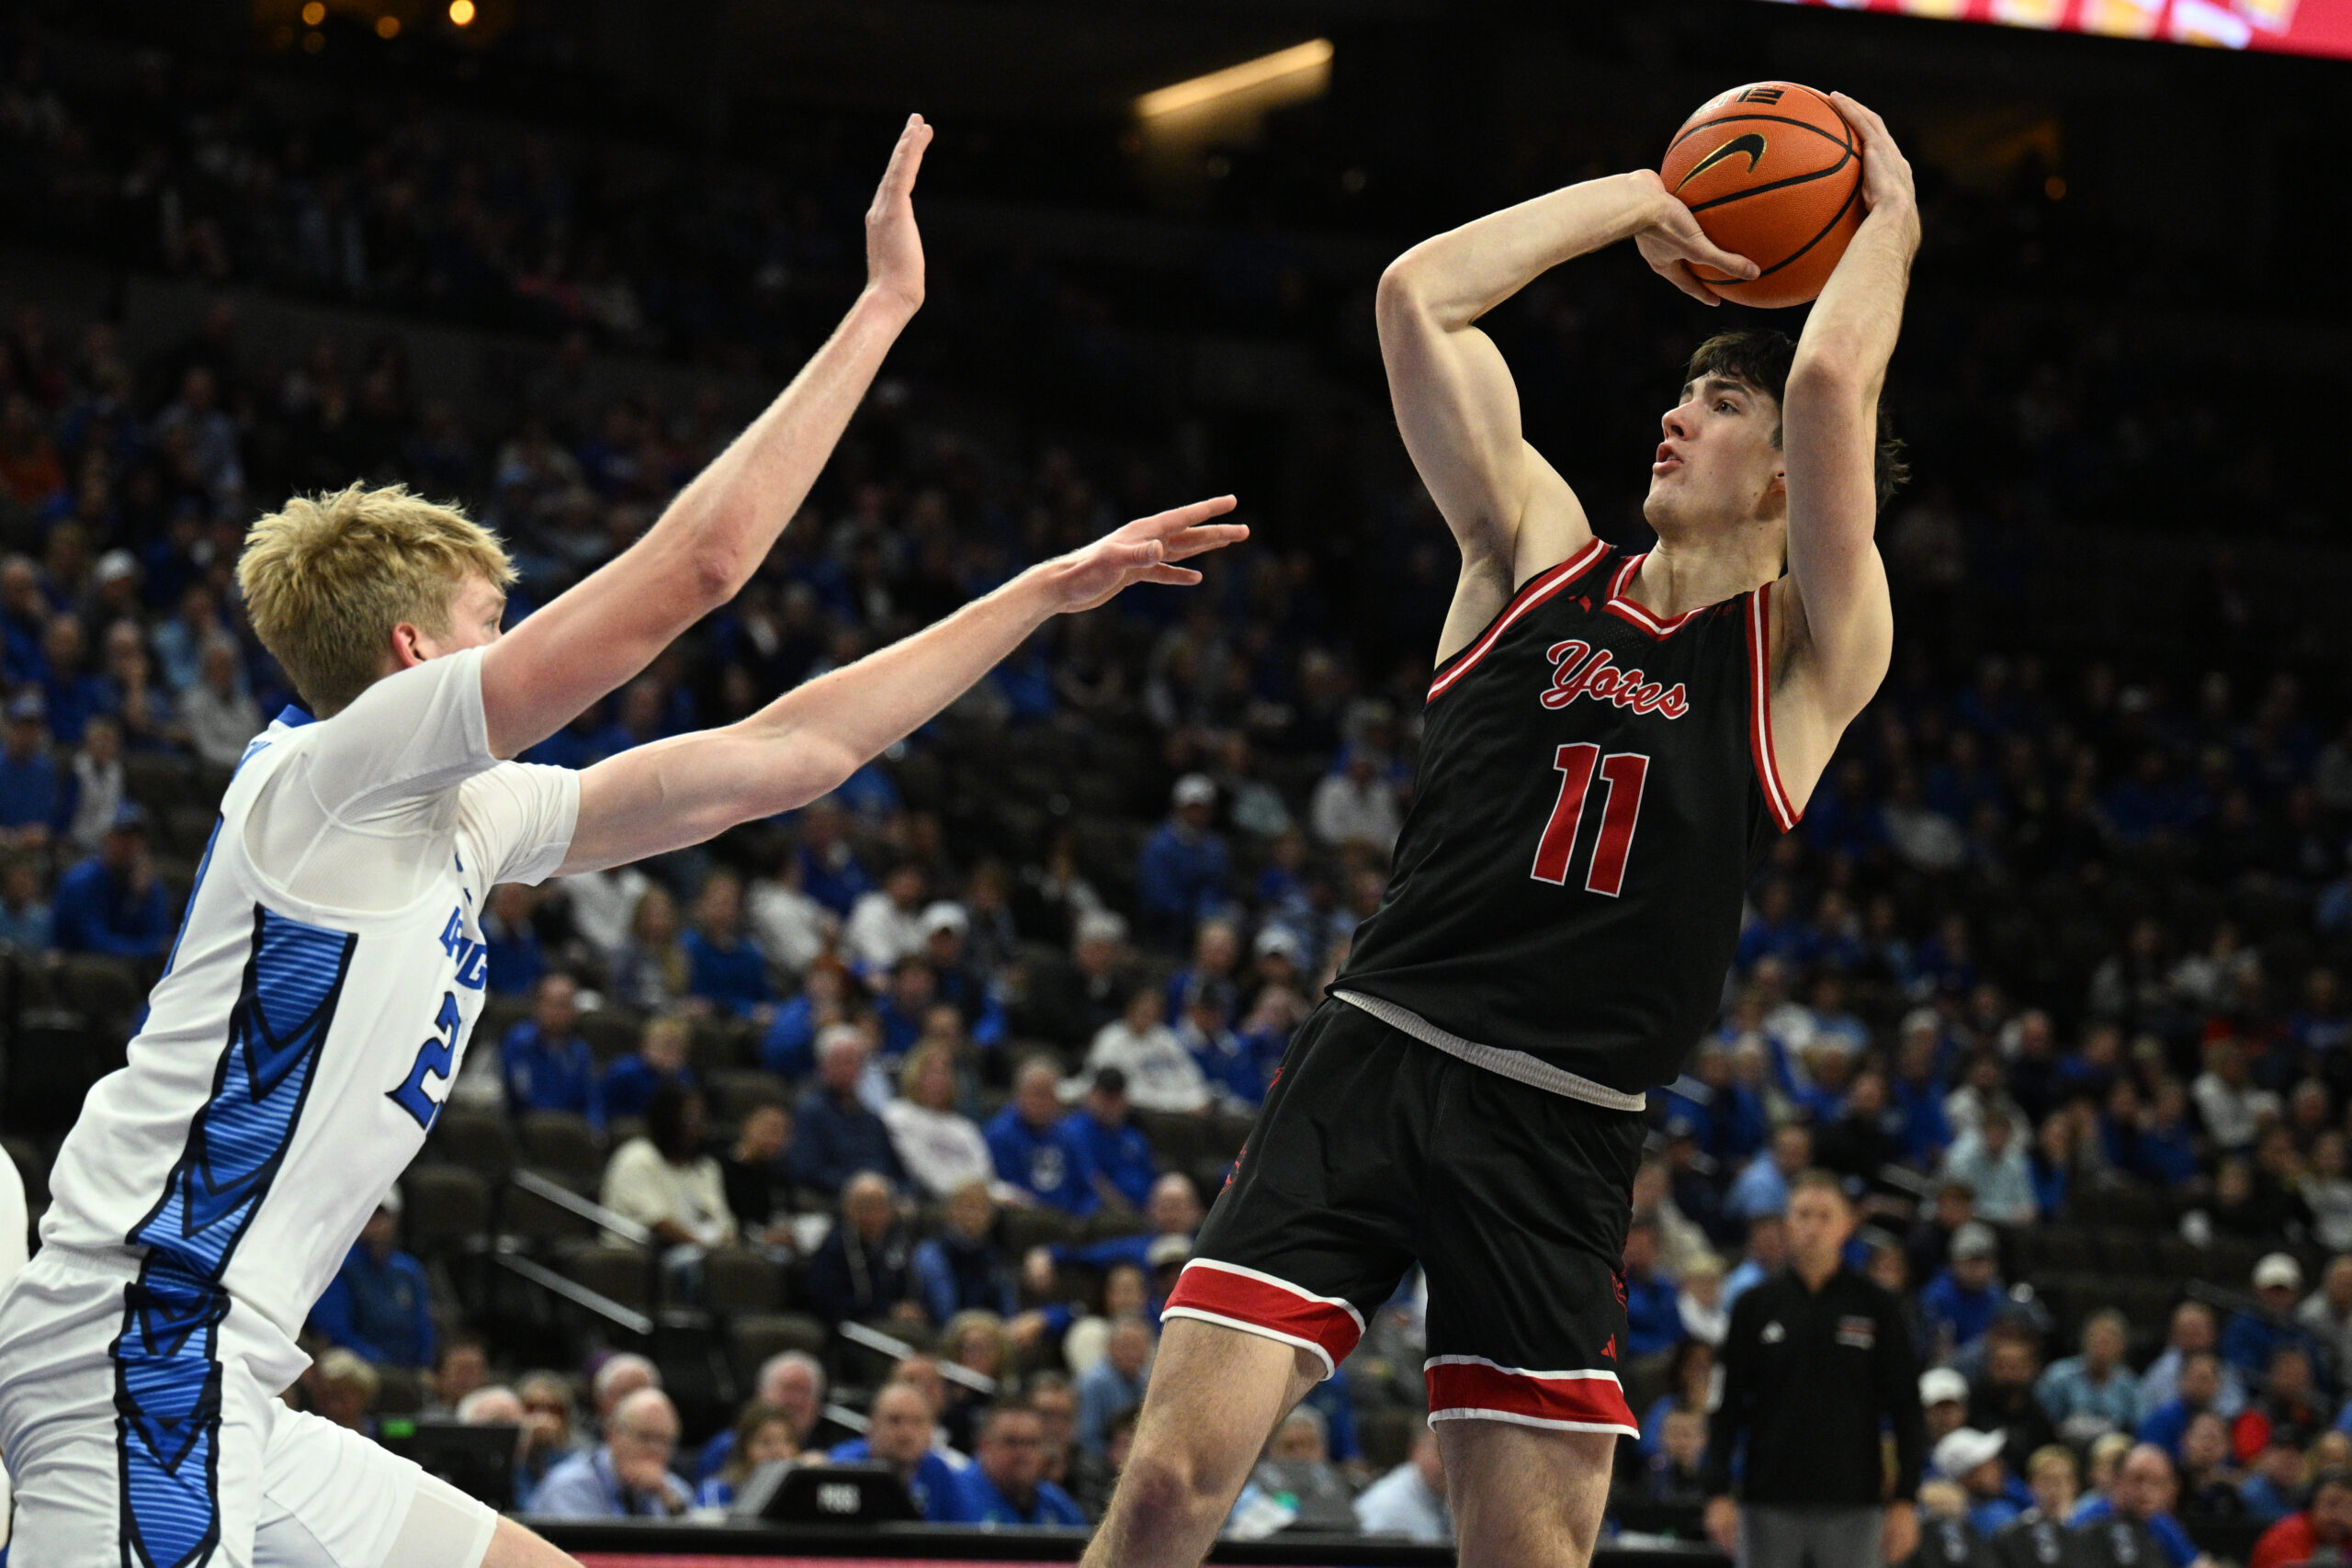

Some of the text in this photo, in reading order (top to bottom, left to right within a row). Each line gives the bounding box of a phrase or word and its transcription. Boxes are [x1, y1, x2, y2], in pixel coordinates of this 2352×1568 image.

[1540, 639, 1689, 719] Yotes
[1530, 741, 1650, 897] 11
[385, 991, 461, 1132] 2
